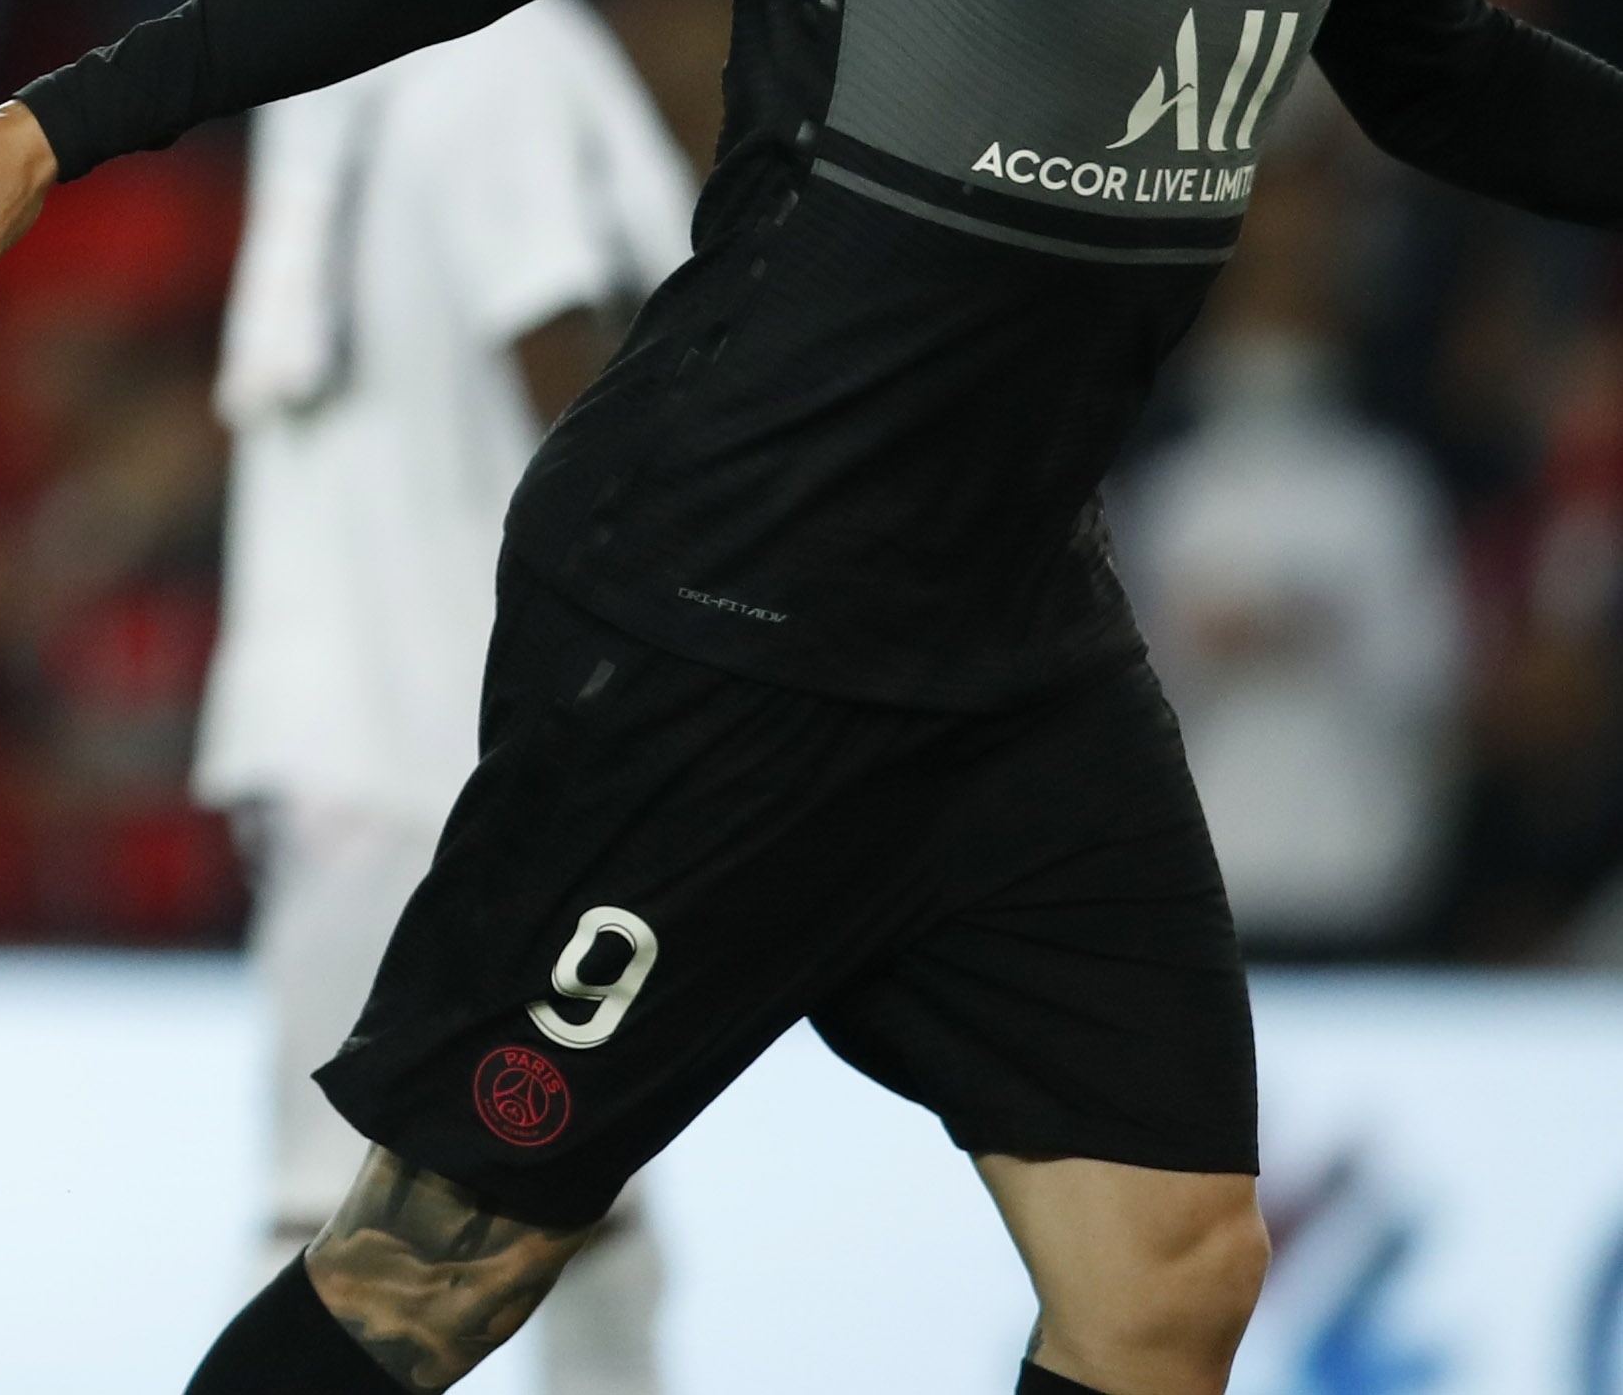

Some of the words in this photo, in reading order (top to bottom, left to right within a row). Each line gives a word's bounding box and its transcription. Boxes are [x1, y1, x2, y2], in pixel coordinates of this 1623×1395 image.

[971, 141, 1128, 201] ACCOR
[1134, 168, 1198, 202] LIVE
[527, 905, 658, 1049] 9
[504, 1051, 561, 1094] PARIS
